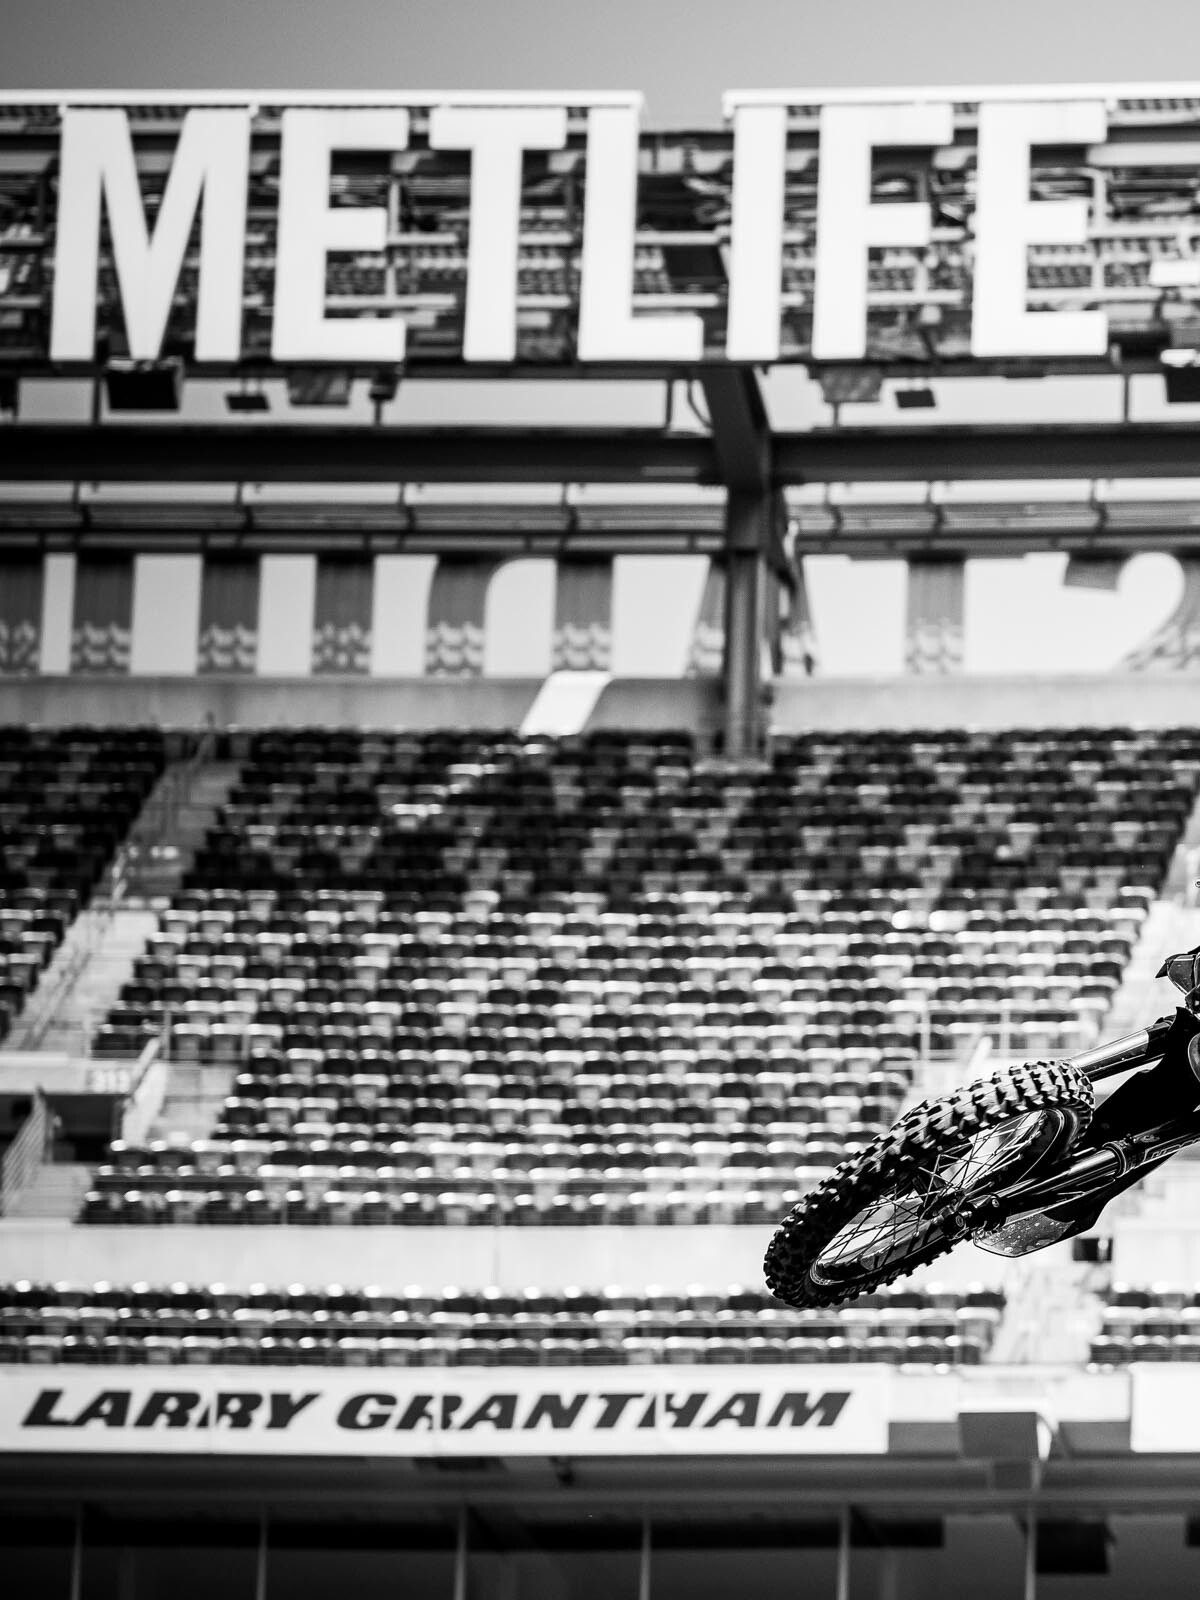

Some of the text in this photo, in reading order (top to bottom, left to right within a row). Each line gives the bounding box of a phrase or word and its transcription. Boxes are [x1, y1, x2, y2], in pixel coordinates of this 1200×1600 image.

[50, 101, 1109, 363] METLIFE
[21, 1389, 851, 1431] LARRY GRANTHAM
